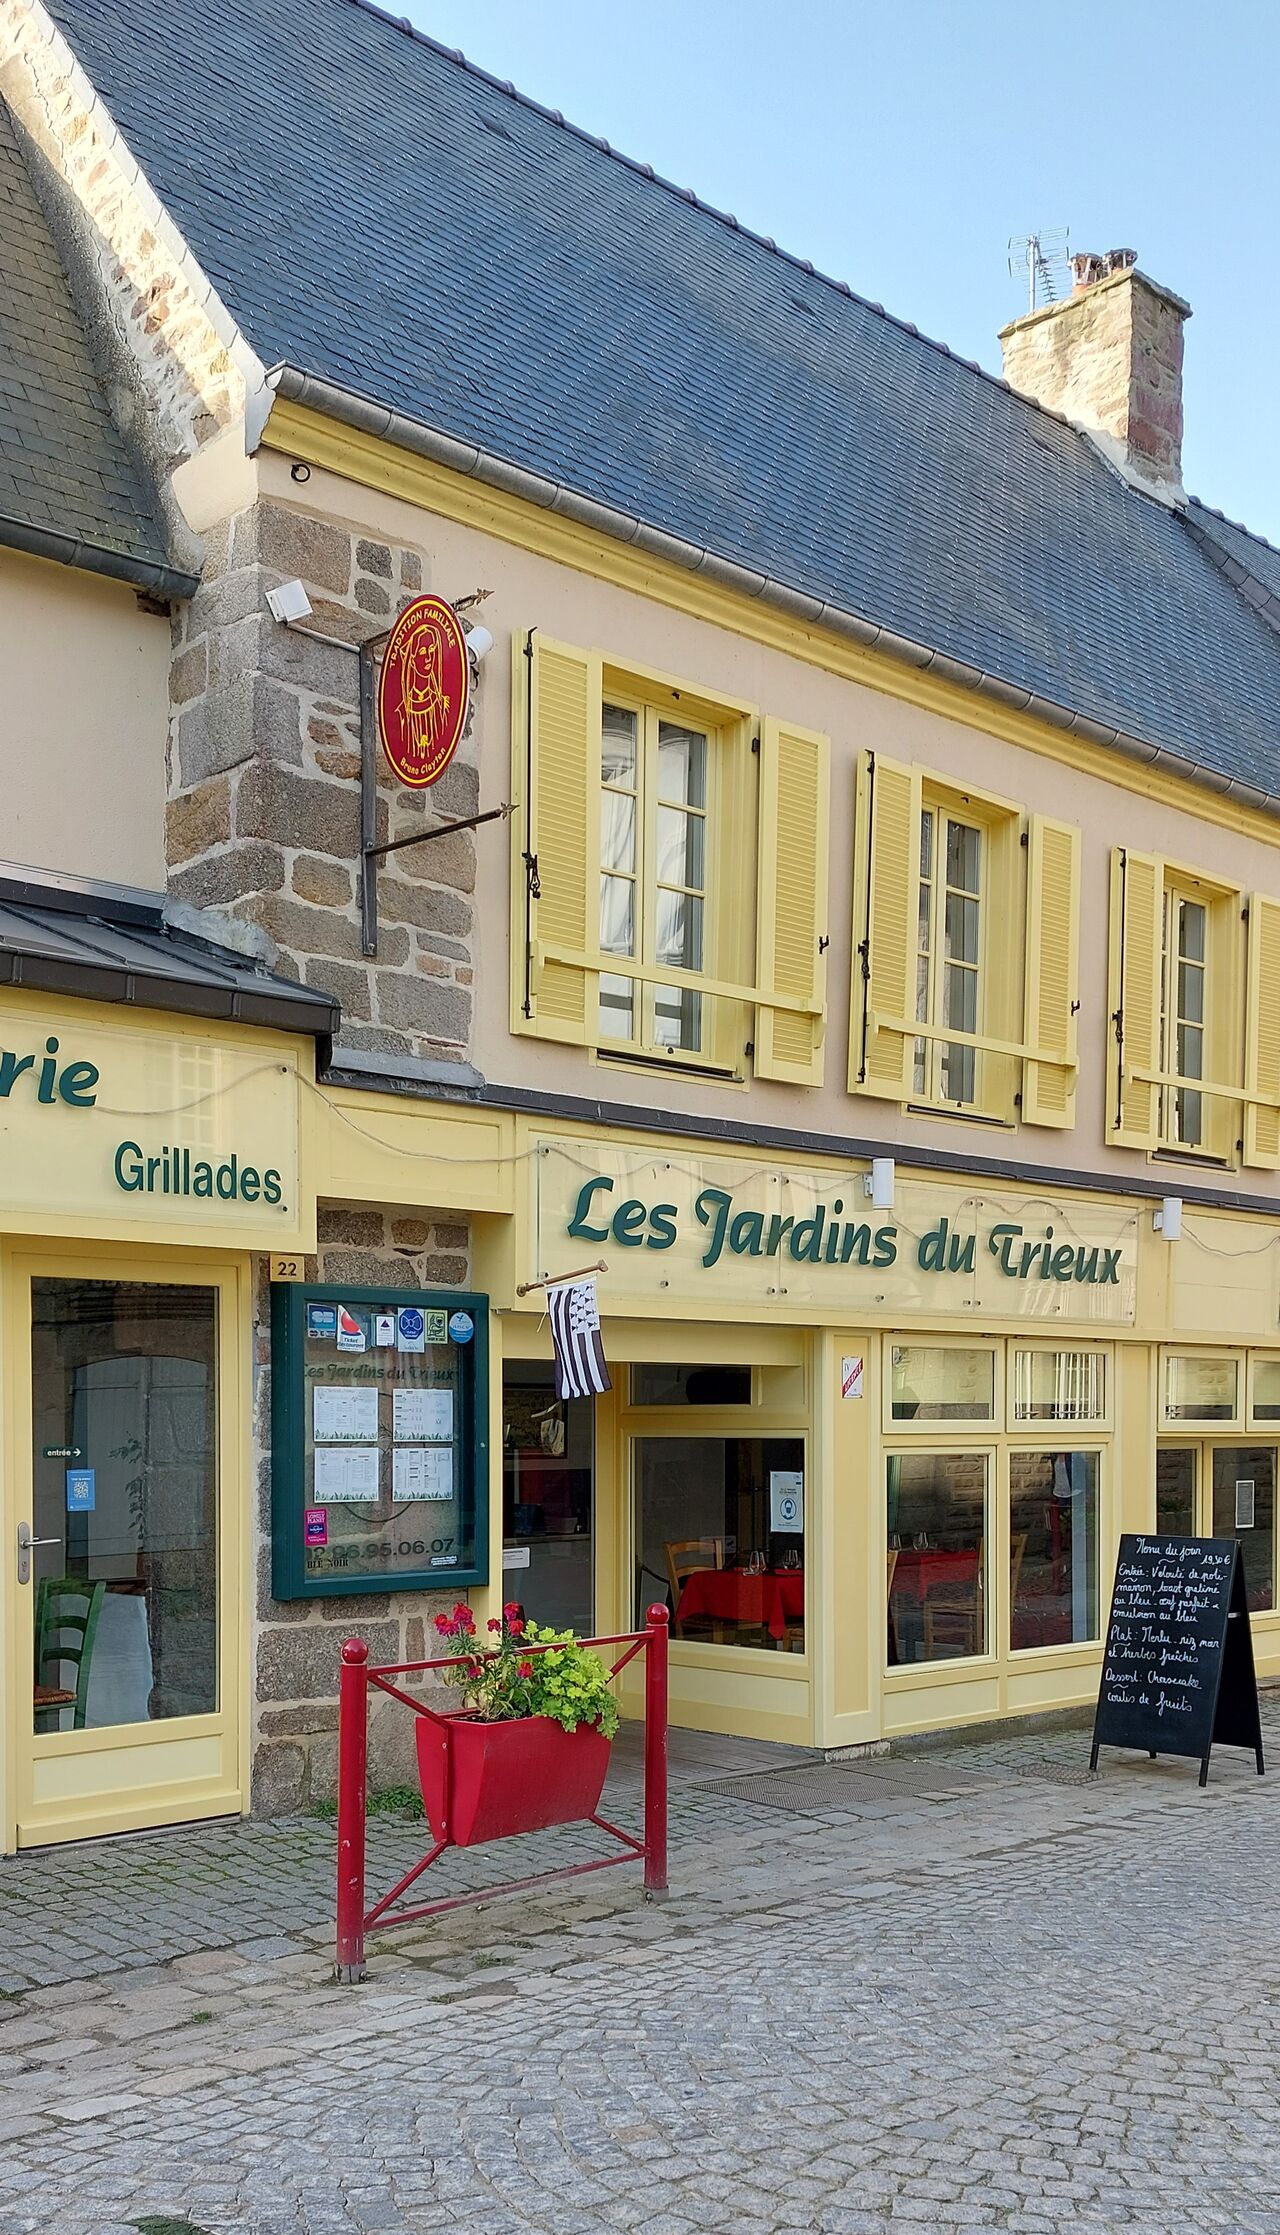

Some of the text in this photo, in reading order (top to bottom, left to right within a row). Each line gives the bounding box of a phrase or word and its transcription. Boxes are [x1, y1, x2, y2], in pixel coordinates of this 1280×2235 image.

[389, 608, 456, 669] TRADITION FAMILIALE
[400, 756, 419, 775] Bruno
[0, 1037, 99, 1107] rie
[114, 1140, 282, 1204] Grillades
[567, 1176, 1122, 1284] Les Jardins du Trieux
[278, 1261, 297, 1276] 22
[327, 1363, 384, 1380] Jardins
[387, 1366, 404, 1380] du
[47, 1448, 71, 1457] entrée
[1136, 1537, 1201, 1561] Menu du jour
[1188, 1568, 1199, 1579] de
[1114, 1597, 1126, 1605] au
[1128, 1593, 1151, 1606] bleu
[1159, 1612, 1171, 1620] au
[1175, 1609, 1199, 1623] bleu
[1108, 1647, 1118, 1658] et
[1120, 1647, 1157, 1660] herbes
[1107, 1690, 1193, 1717] coulis de fruits
